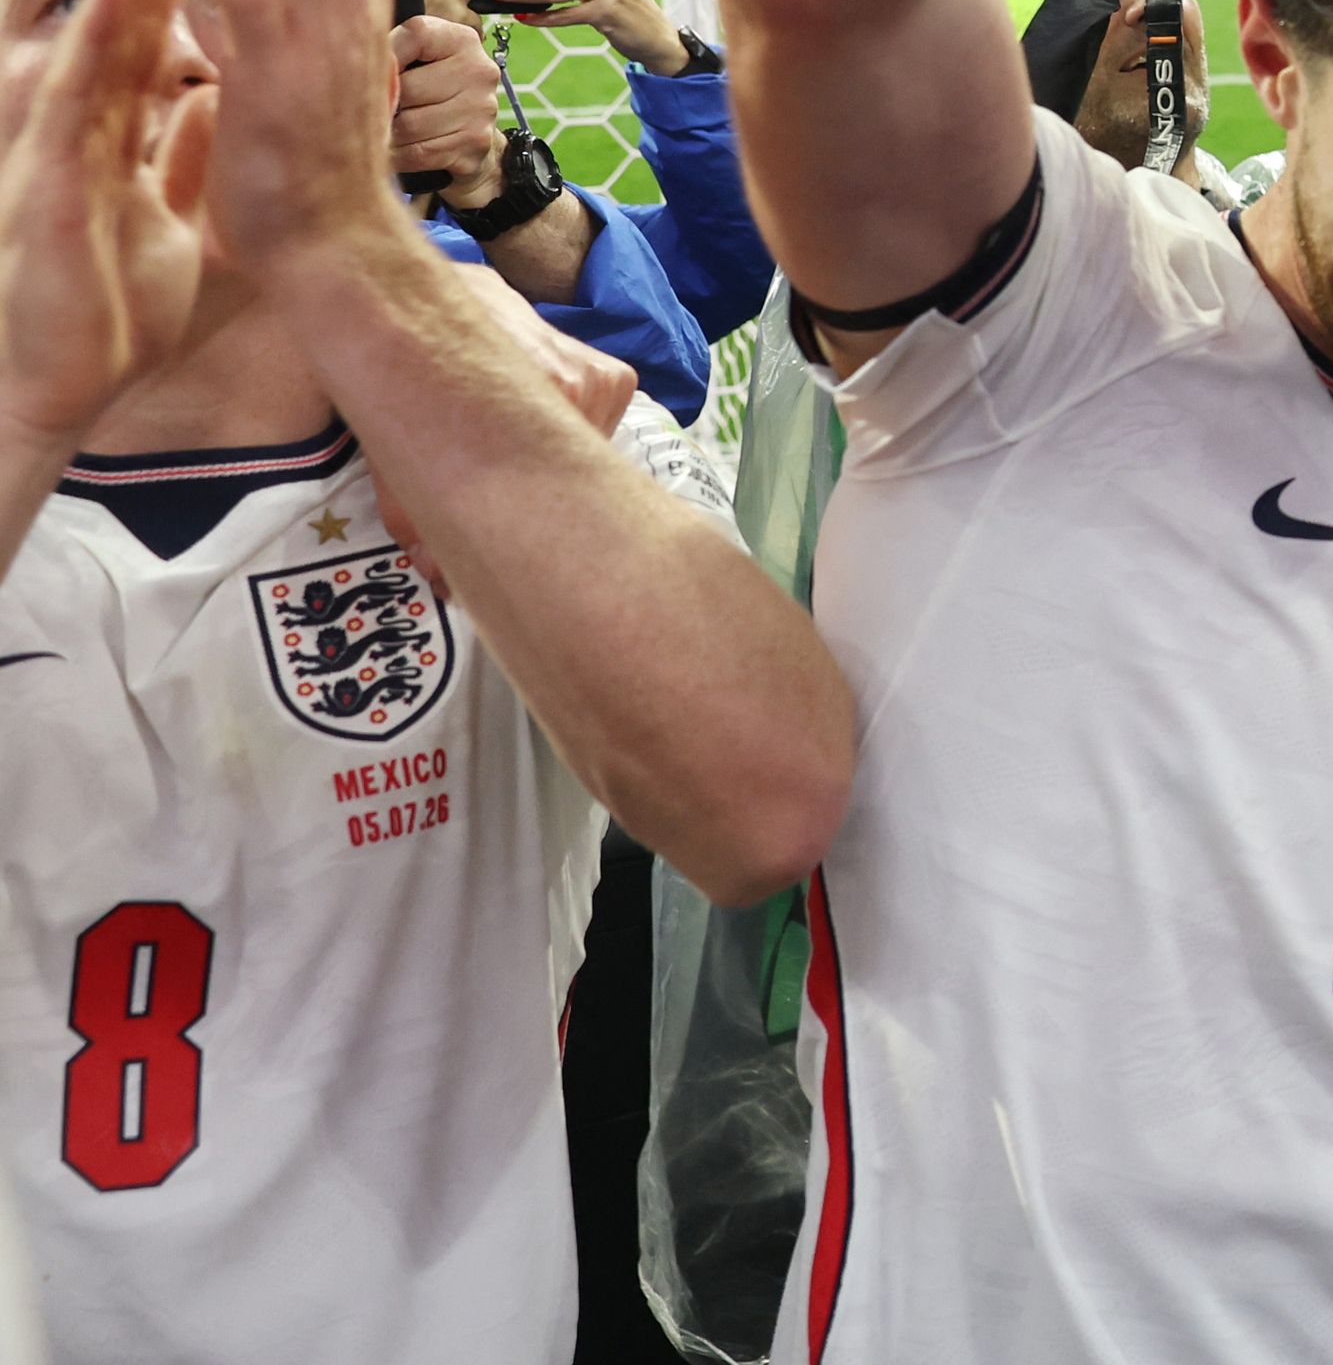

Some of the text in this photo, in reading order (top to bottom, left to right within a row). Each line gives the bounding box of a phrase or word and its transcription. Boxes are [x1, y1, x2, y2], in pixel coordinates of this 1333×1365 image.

[333, 747, 447, 803] MEXICO
[347, 793, 450, 847] 05.07.26
[61, 901, 215, 1192] 8
